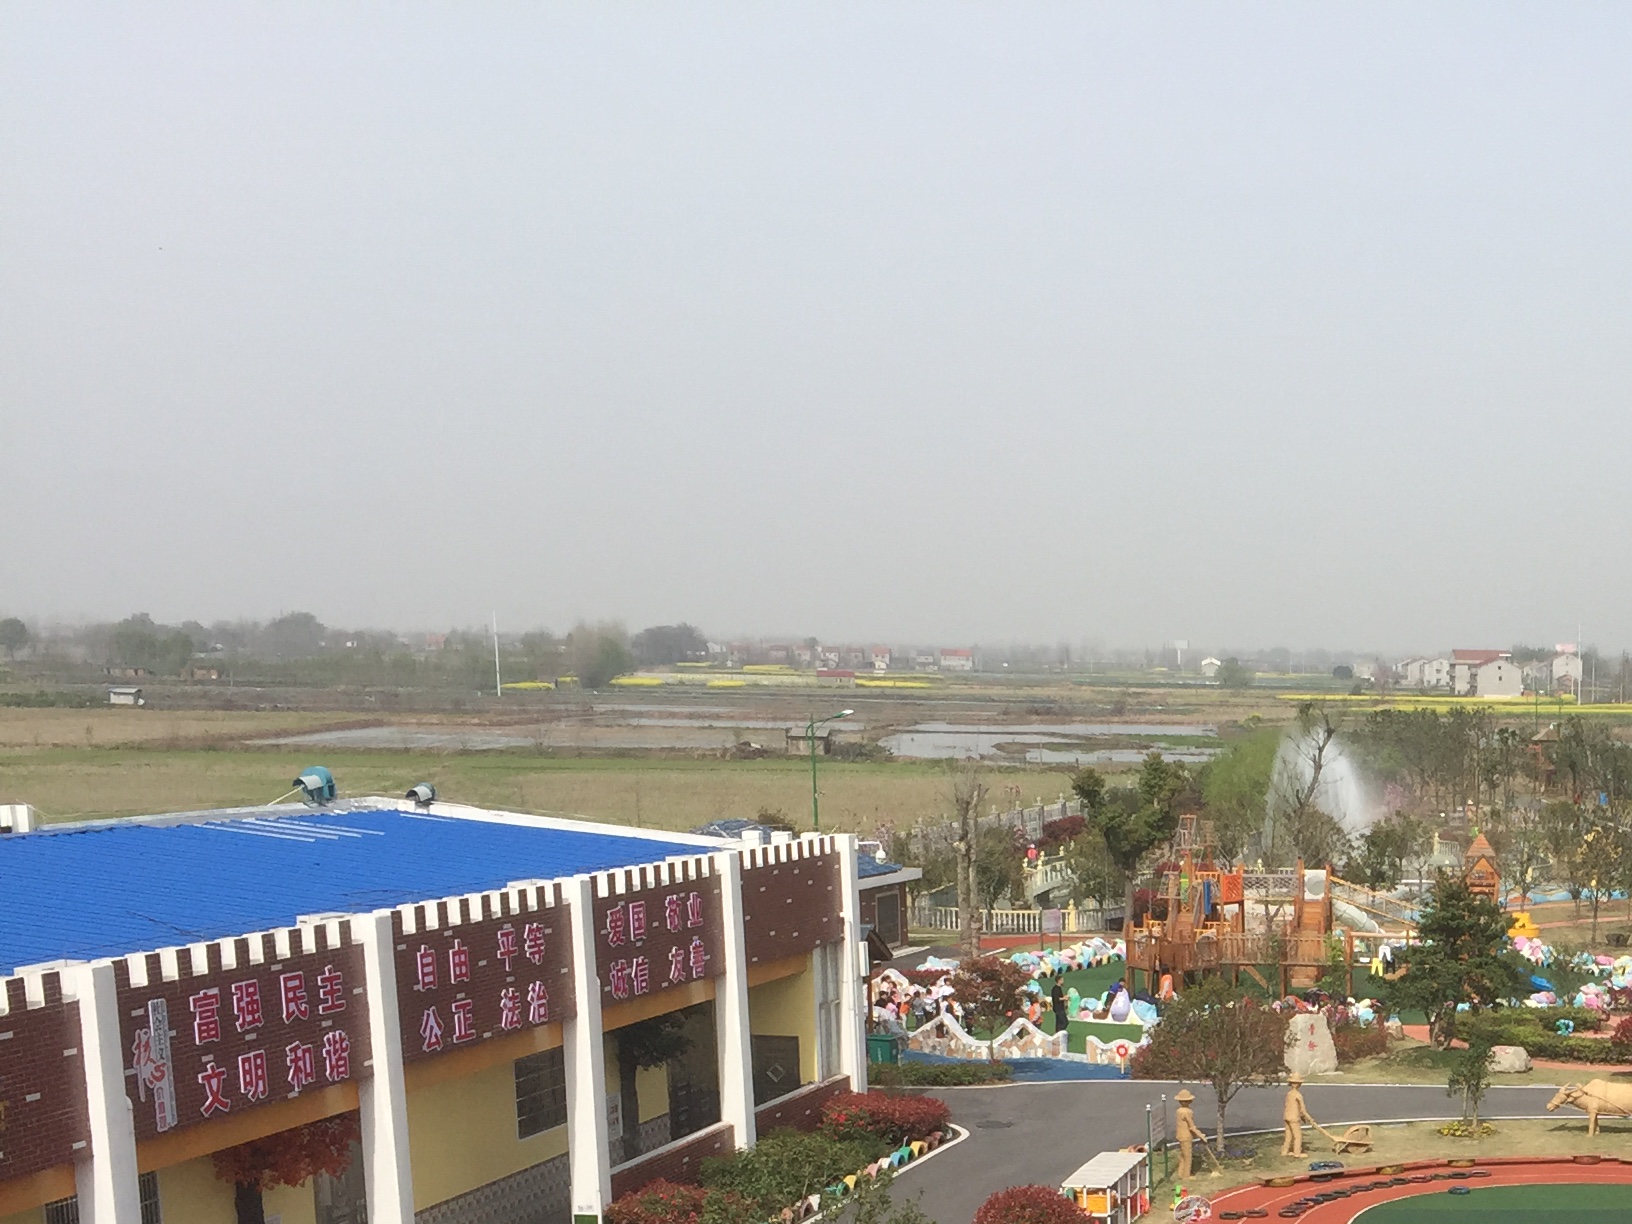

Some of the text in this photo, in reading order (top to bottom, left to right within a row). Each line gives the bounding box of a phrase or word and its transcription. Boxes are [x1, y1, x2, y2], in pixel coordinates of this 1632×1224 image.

[606, 891, 704, 948] 爱国 敬业
[416, 922, 547, 992] 自由 平等
[609, 938, 707, 1000] 诚信 友善
[189, 965, 347, 1046] 富强 民主
[419, 981, 551, 1053] 公正 法治
[197, 1049, 269, 1118] 文明
[287, 1029, 351, 1093] 和谐
